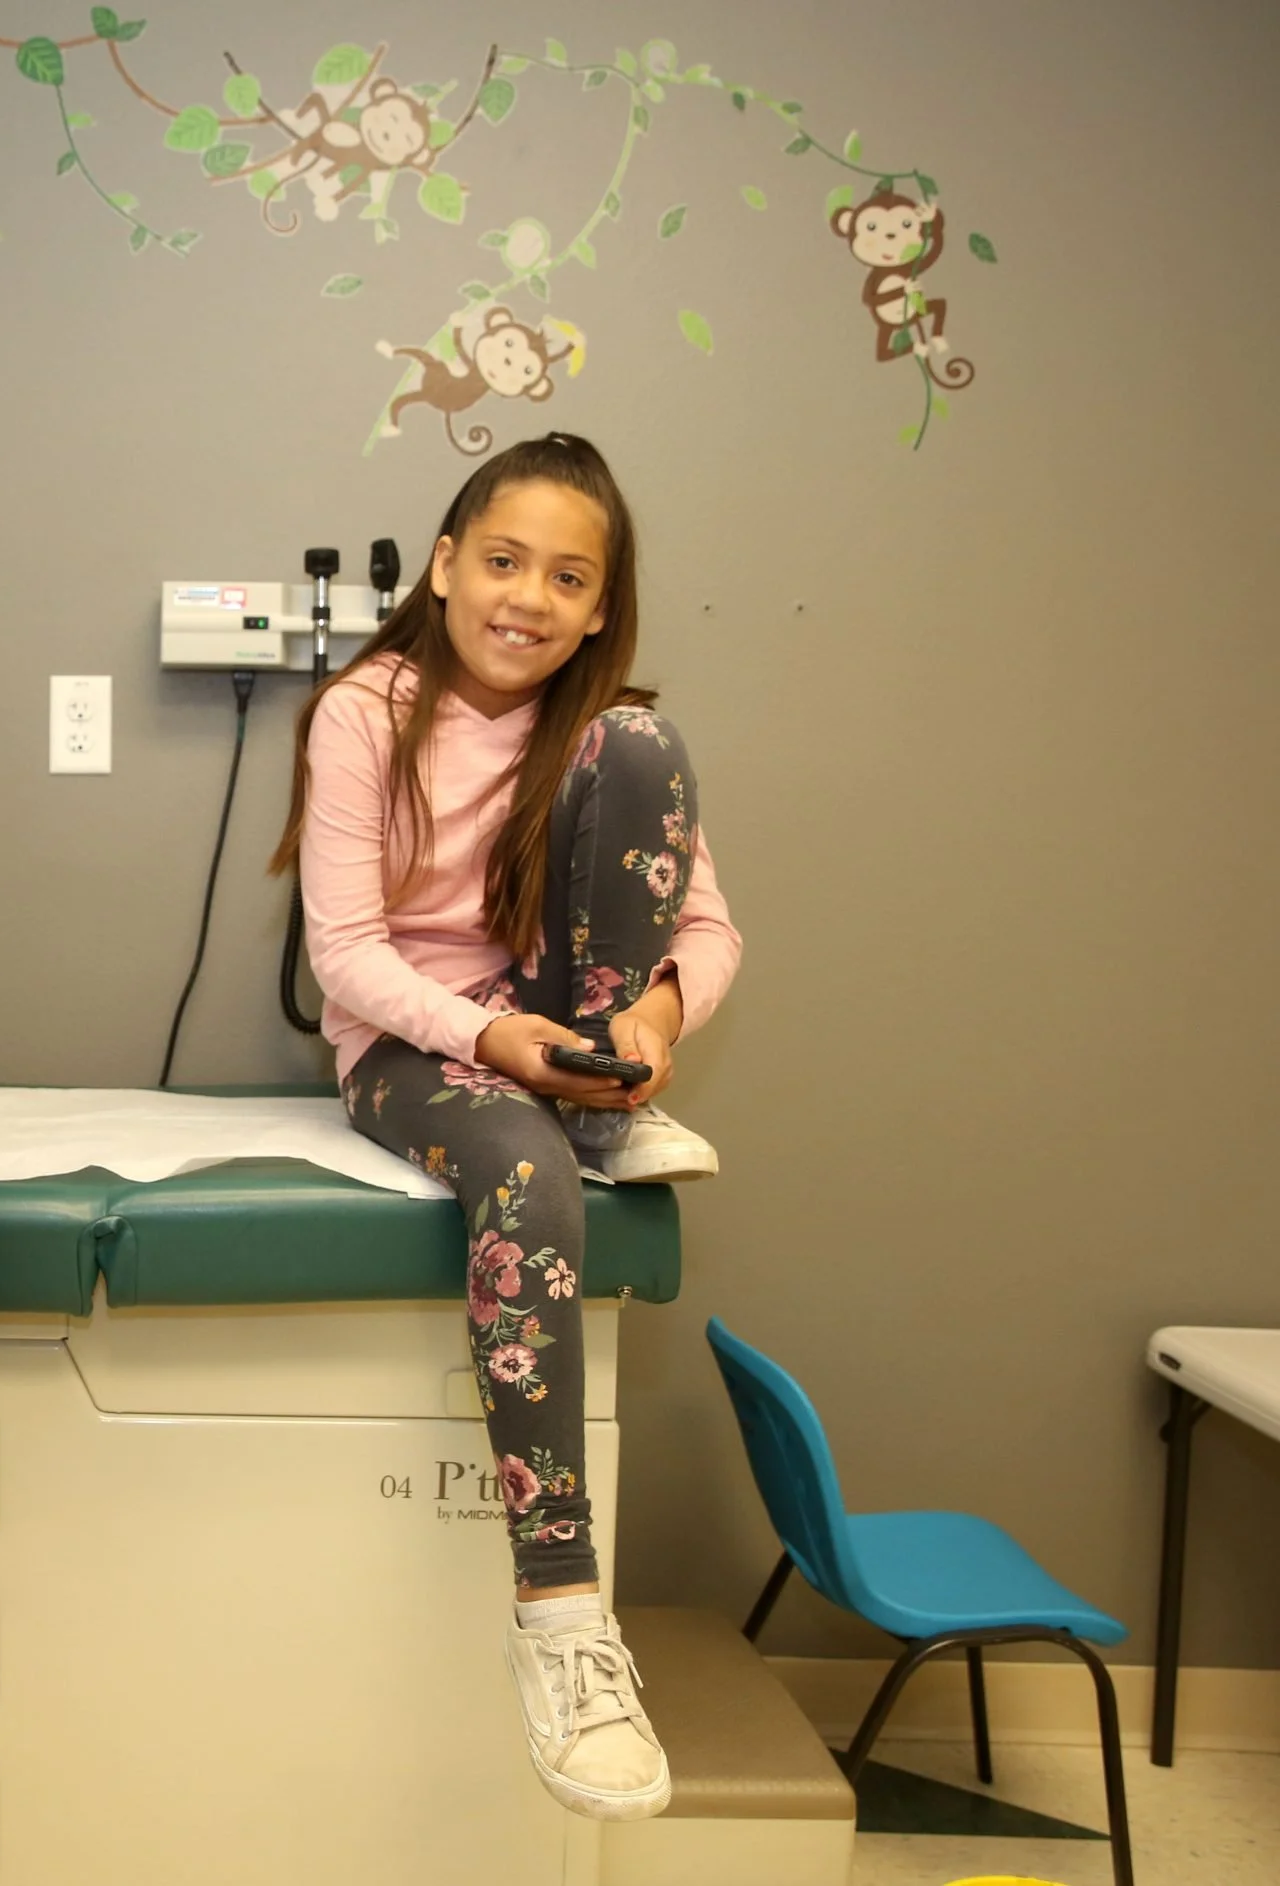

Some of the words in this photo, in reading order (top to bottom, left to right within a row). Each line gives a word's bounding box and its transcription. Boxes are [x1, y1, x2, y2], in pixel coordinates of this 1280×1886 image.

[380, 1474, 413, 1499] 04
[437, 1506, 453, 1524] by
[457, 1509, 507, 1521] MIDM
